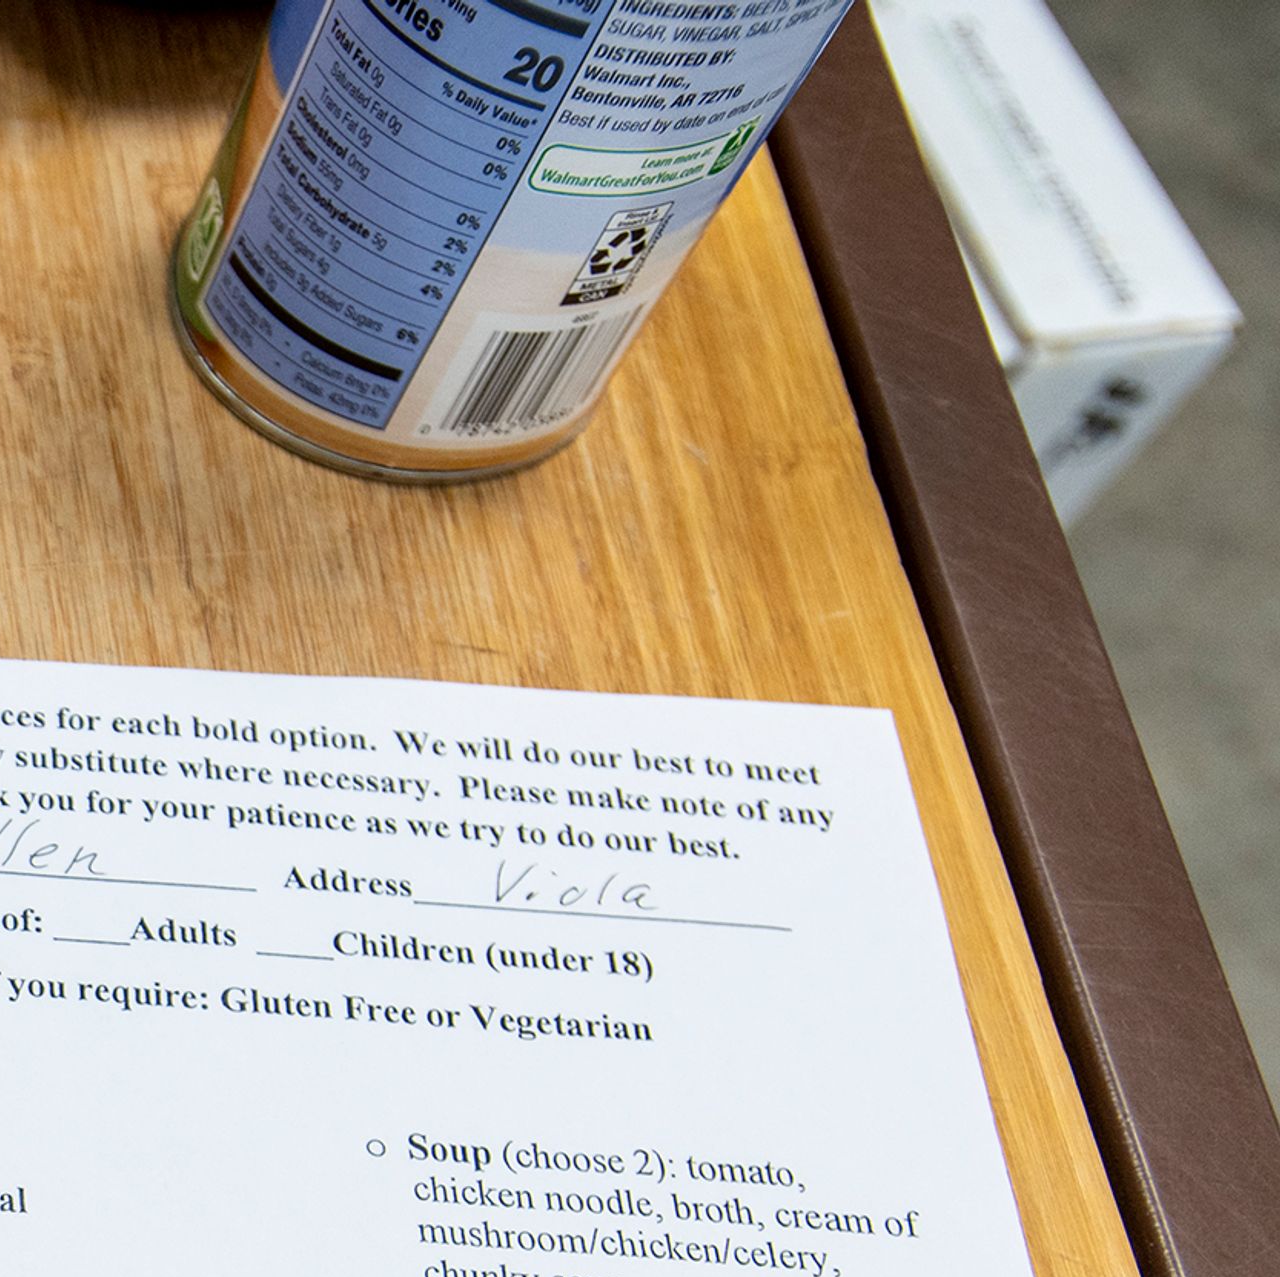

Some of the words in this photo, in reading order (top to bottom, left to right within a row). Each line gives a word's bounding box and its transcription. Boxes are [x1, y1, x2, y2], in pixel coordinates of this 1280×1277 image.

[608, 19, 669, 42] SUGAR,
[673, 21, 743, 43] VINEGAR,
[502, 46, 566, 93] 20
[594, 45, 707, 67] DISTRIBUTED
[709, 48, 736, 65] BY:
[329, 18, 354, 54] Total
[352, 50, 372, 66] Fat
[370, 66, 386, 88] 0g
[496, 136, 522, 156] 0%
[584, 66, 656, 88] Walmart
[657, 73, 692, 89] Inc.,
[442, 81, 453, 98] %
[455, 90, 489, 116] Daily
[571, 86, 666, 110] Bentonville,
[671, 93, 696, 109] AR
[558, 109, 593, 127] Best
[595, 112, 609, 130] if
[611, 115, 648, 133] used
[653, 118, 671, 135] by
[673, 111, 703, 130] date
[708, 109, 725, 124] on
[297, 102, 348, 161] Cholesterol
[346, 153, 371, 181] 0mg
[456, 213, 481, 231] 0%
[541, 163, 705, 188] WalmartGreatForYou.com
[641, 154, 672, 169] Learn
[674, 150, 700, 165] more
[297, 173, 371, 239] Carbohydrate
[372, 233, 388, 251] 5g
[432, 260, 456, 278] 2%
[57, 707, 101, 731] for
[112, 714, 181, 736] each
[192, 716, 259, 743] bold
[270, 726, 376, 752] option.
[393, 730, 445, 756] We
[456, 737, 512, 761] will
[523, 741, 559, 764] do
[570, 751, 622, 768] our
[632, 748, 694, 774] best
[705, 758, 733, 777] to
[745, 764, 819, 785] meet
[284, 867, 412, 897] Address
[495, 859, 659, 911] Viola
[7, 978, 66, 1002] you
[78, 982, 208, 1011] require:
[221, 987, 332, 1018] Gluten
[343, 995, 416, 1025] Free
[427, 1009, 460, 1028] or
[469, 1005, 652, 1041] Vegetarian
[418, 1221, 840, 1277] mushroom/chicken/celery,
